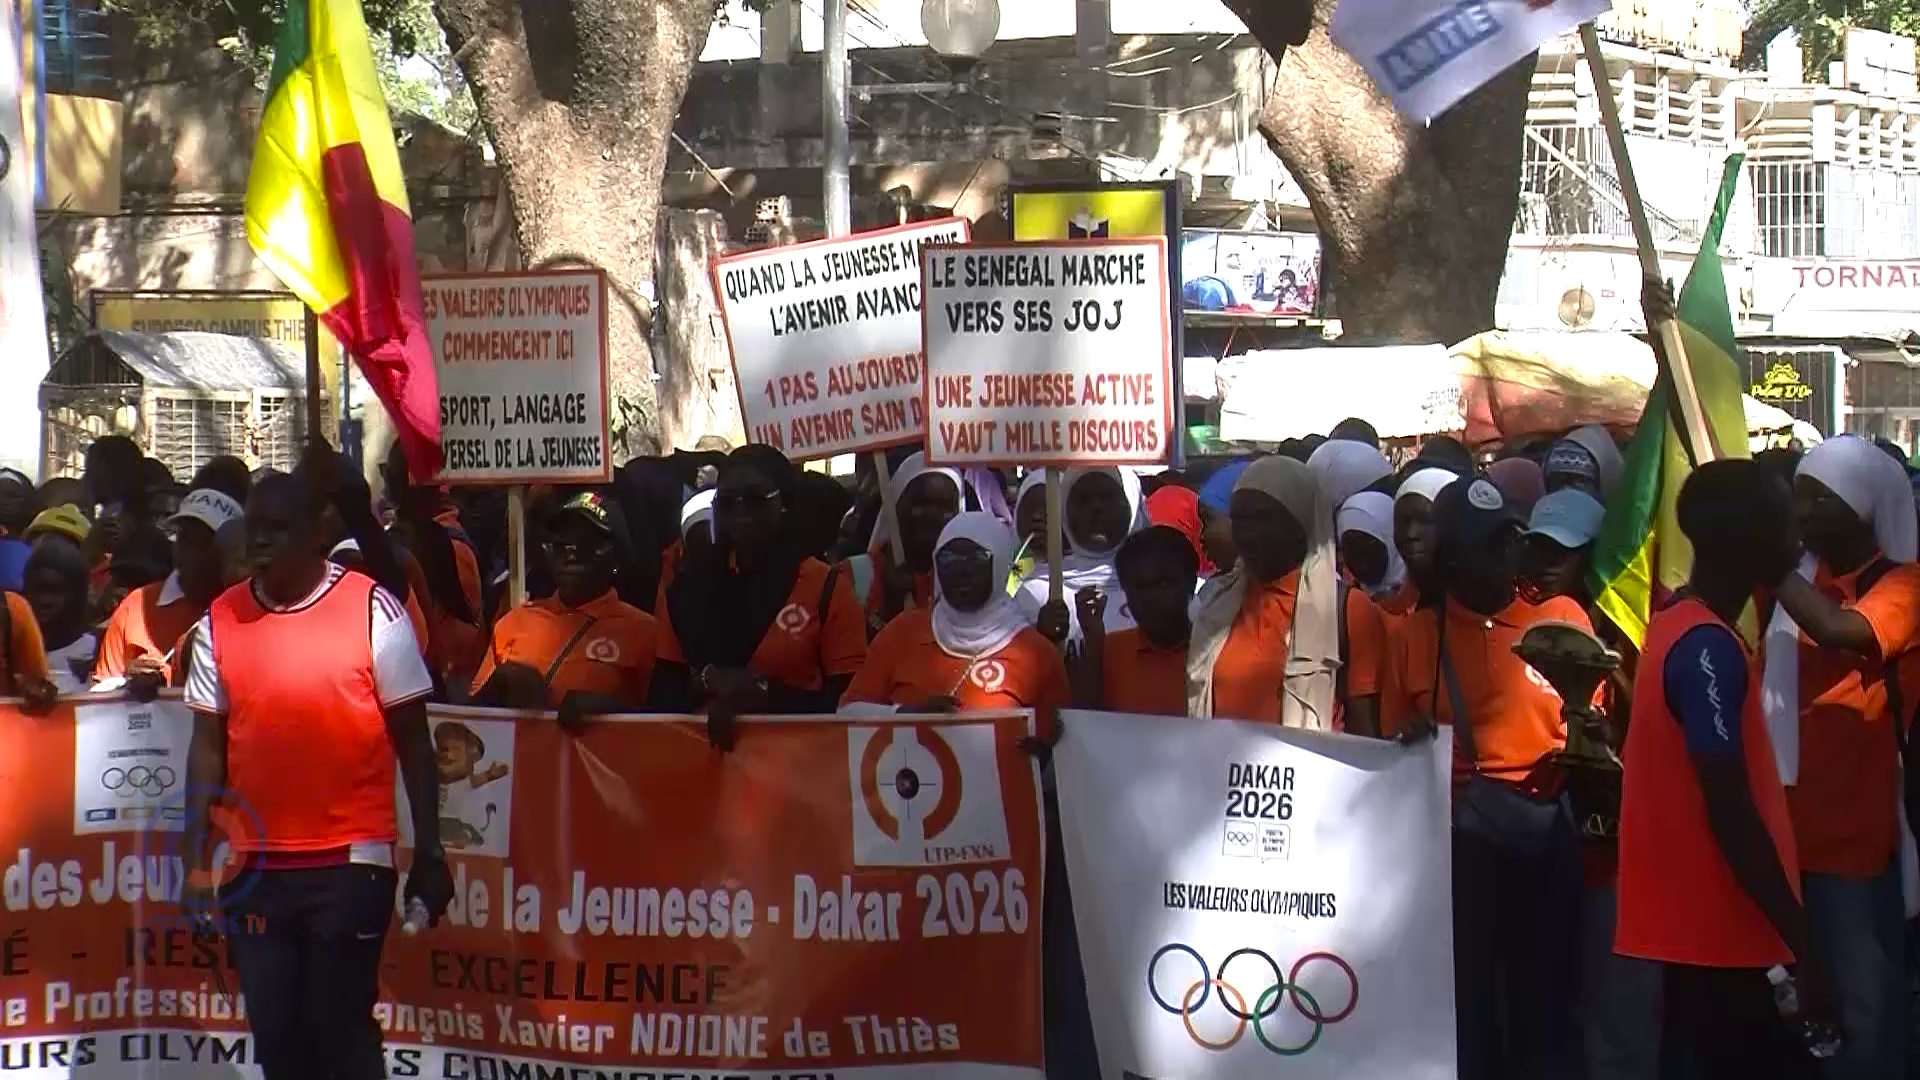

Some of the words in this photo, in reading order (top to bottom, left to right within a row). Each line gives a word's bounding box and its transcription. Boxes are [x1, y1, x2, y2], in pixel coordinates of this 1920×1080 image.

[725, 263, 785, 303] QUAND
[791, 258, 816, 288] LA
[822, 242, 899, 282] JEUNESSE
[931, 256, 955, 288] LE
[964, 254, 1054, 288] SENEGAL
[1062, 254, 1145, 286] MARCHE
[423, 287, 438, 319] ES
[442, 286, 505, 320] VALEURS
[509, 284, 591, 319] OLYMPIQUES
[770, 295, 849, 336] L'AVENIR
[856, 282, 921, 320] AVANC
[945, 300, 1004, 333] VERS
[1013, 300, 1053, 332] SES
[1064, 299, 1123, 332] JOJ
[274, 319, 305, 341] THIE
[443, 329, 551, 363] COMMENCENT
[556, 329, 575, 360] ICI
[827, 352, 921, 397] AUJOURD'
[935, 375, 972, 409] UNE
[979, 373, 1076, 408] JEUNESSE
[1082, 373, 1154, 407] ACTIVE
[441, 394, 495, 429] SPORT,
[503, 393, 586, 424] LANGAGE
[756, 422, 784, 451] UN
[790, 408, 856, 450] AVENIR
[861, 399, 906, 435] SAIN
[443, 438, 490, 470] VERSEL
[495, 438, 512, 469] DE
[517, 437, 535, 468] LA
[540, 435, 600, 467] JEUNESSE
[939, 420, 997, 454] VAUT
[1005, 420, 1064, 452] MILLE
[1068, 419, 1158, 452] DISCOURS
[1228, 763, 1295, 790] DAKAR
[1226, 790, 1293, 820] 2026
[4, 848, 82, 912] des
[448, 863, 489, 928] de
[504, 867, 540, 932] la
[558, 871, 753, 938] Jeunesse
[793, 873, 902, 941] Dakar
[916, 868, 1028, 938] 2026
[1164, 882, 1186, 908] LES
[1188, 884, 1248, 912] VALEURS
[1250, 888, 1336, 919] OLYMPIQUES
[125, 926, 235, 969] RES
[430, 949, 730, 1005] EXCELLENCE
[0, 998, 27, 1026] e
[45, 977, 246, 1024] Professio
[372, 1002, 484, 1042] ançois
[498, 1003, 614, 1054] Xavier
[631, 1012, 768, 1058] NDIONE
[784, 1018, 830, 1058] de
[843, 1015, 960, 1054] Thiès
[1, 1037, 96, 1069] URS
[120, 1033, 247, 1065] OLYM
